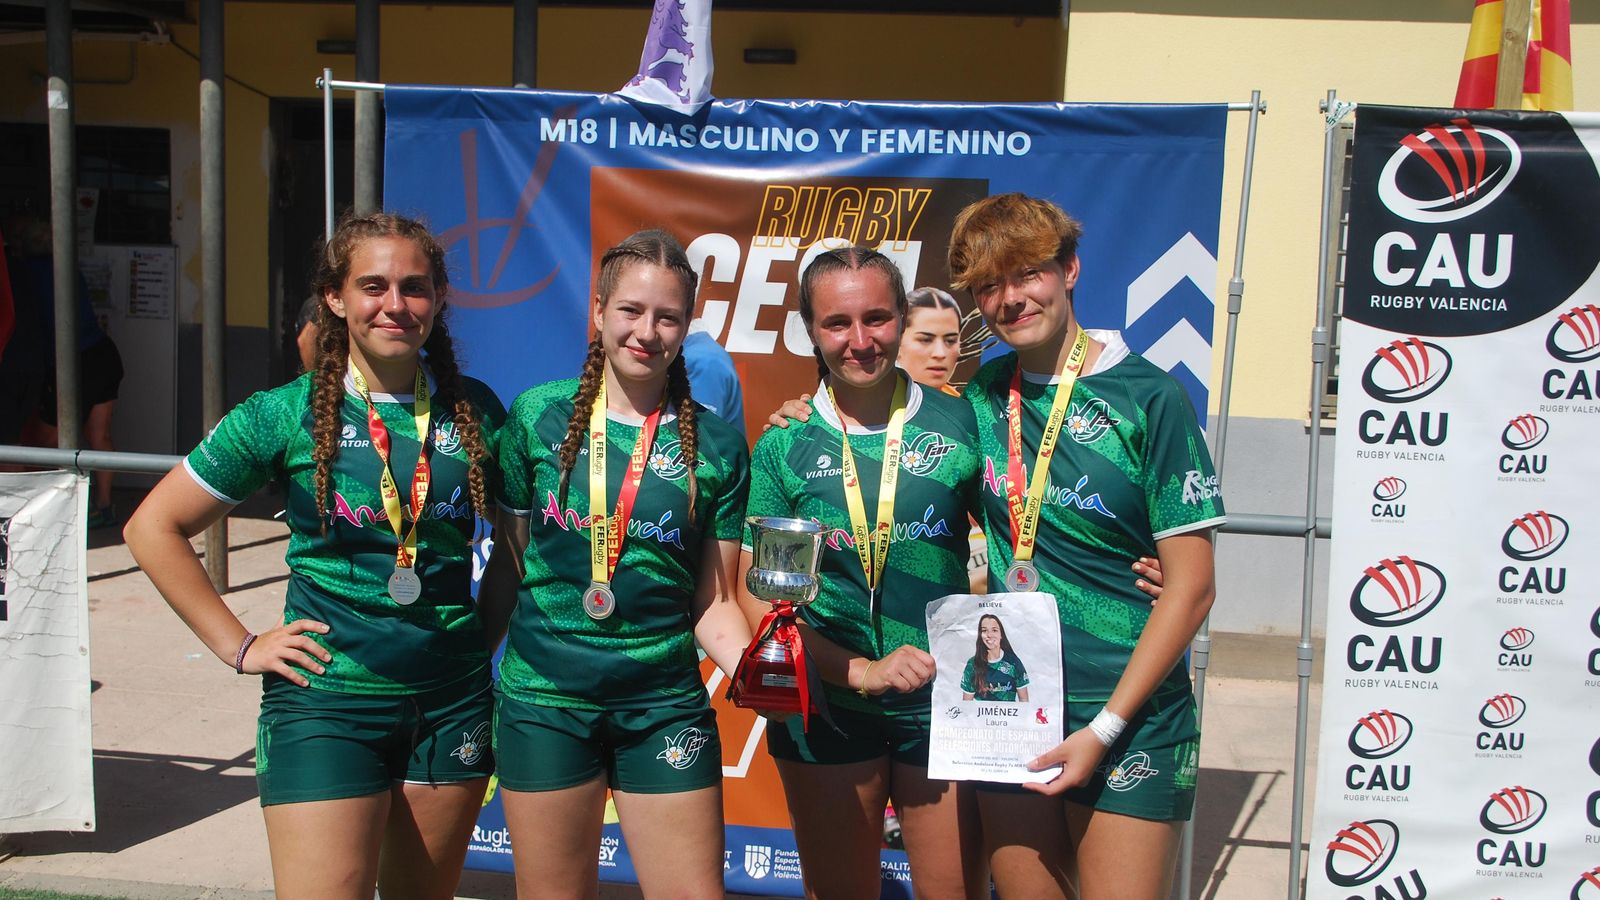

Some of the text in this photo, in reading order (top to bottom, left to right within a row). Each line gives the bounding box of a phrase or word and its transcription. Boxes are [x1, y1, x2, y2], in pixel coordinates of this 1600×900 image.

[540, 117, 598, 144] M18
[629, 121, 819, 152] MASCULINO
[829, 129, 850, 152] Y
[861, 129, 1032, 156] FEMENINO
[753, 184, 933, 252] RUGBY
[1372, 231, 1514, 288] CAU
[1370, 295, 1508, 311] RUGBY VALENCIA
[1542, 368, 1600, 400] CA
[1539, 404, 1600, 413] RUGBY VALEN
[1044, 407, 1061, 446] FERugby
[1358, 409, 1449, 446] CAU
[338, 440, 370, 448] ATOR
[1356, 450, 1445, 461] RUGBY VALENCIA
[1499, 454, 1547, 474] CAU
[806, 468, 843, 480] VIATOR
[1022, 495, 1038, 535] FERugby
[1371, 503, 1406, 517] CAU
[596, 526, 605, 565] FERugby
[857, 525, 867, 563] FERugby
[1498, 566, 1567, 594] CAU
[1496, 597, 1564, 606] RUGBY VALENCIA
[1346, 634, 1443, 674] CAU
[1498, 653, 1533, 666] CAU
[1345, 679, 1439, 690] RUGBY VALENCIA
[1584, 679, 1600, 687] RUG
[977, 705, 1018, 717] JIMÉNEZ
[985, 718, 1008, 727] Laura
[1476, 732, 1525, 751] CAU
[1345, 764, 1411, 791] CAU
[1344, 794, 1409, 802] RUGBY VALENCIA
[1476, 838, 1546, 868] CAU
[1476, 869, 1543, 879] RUGBY VALENCIA
